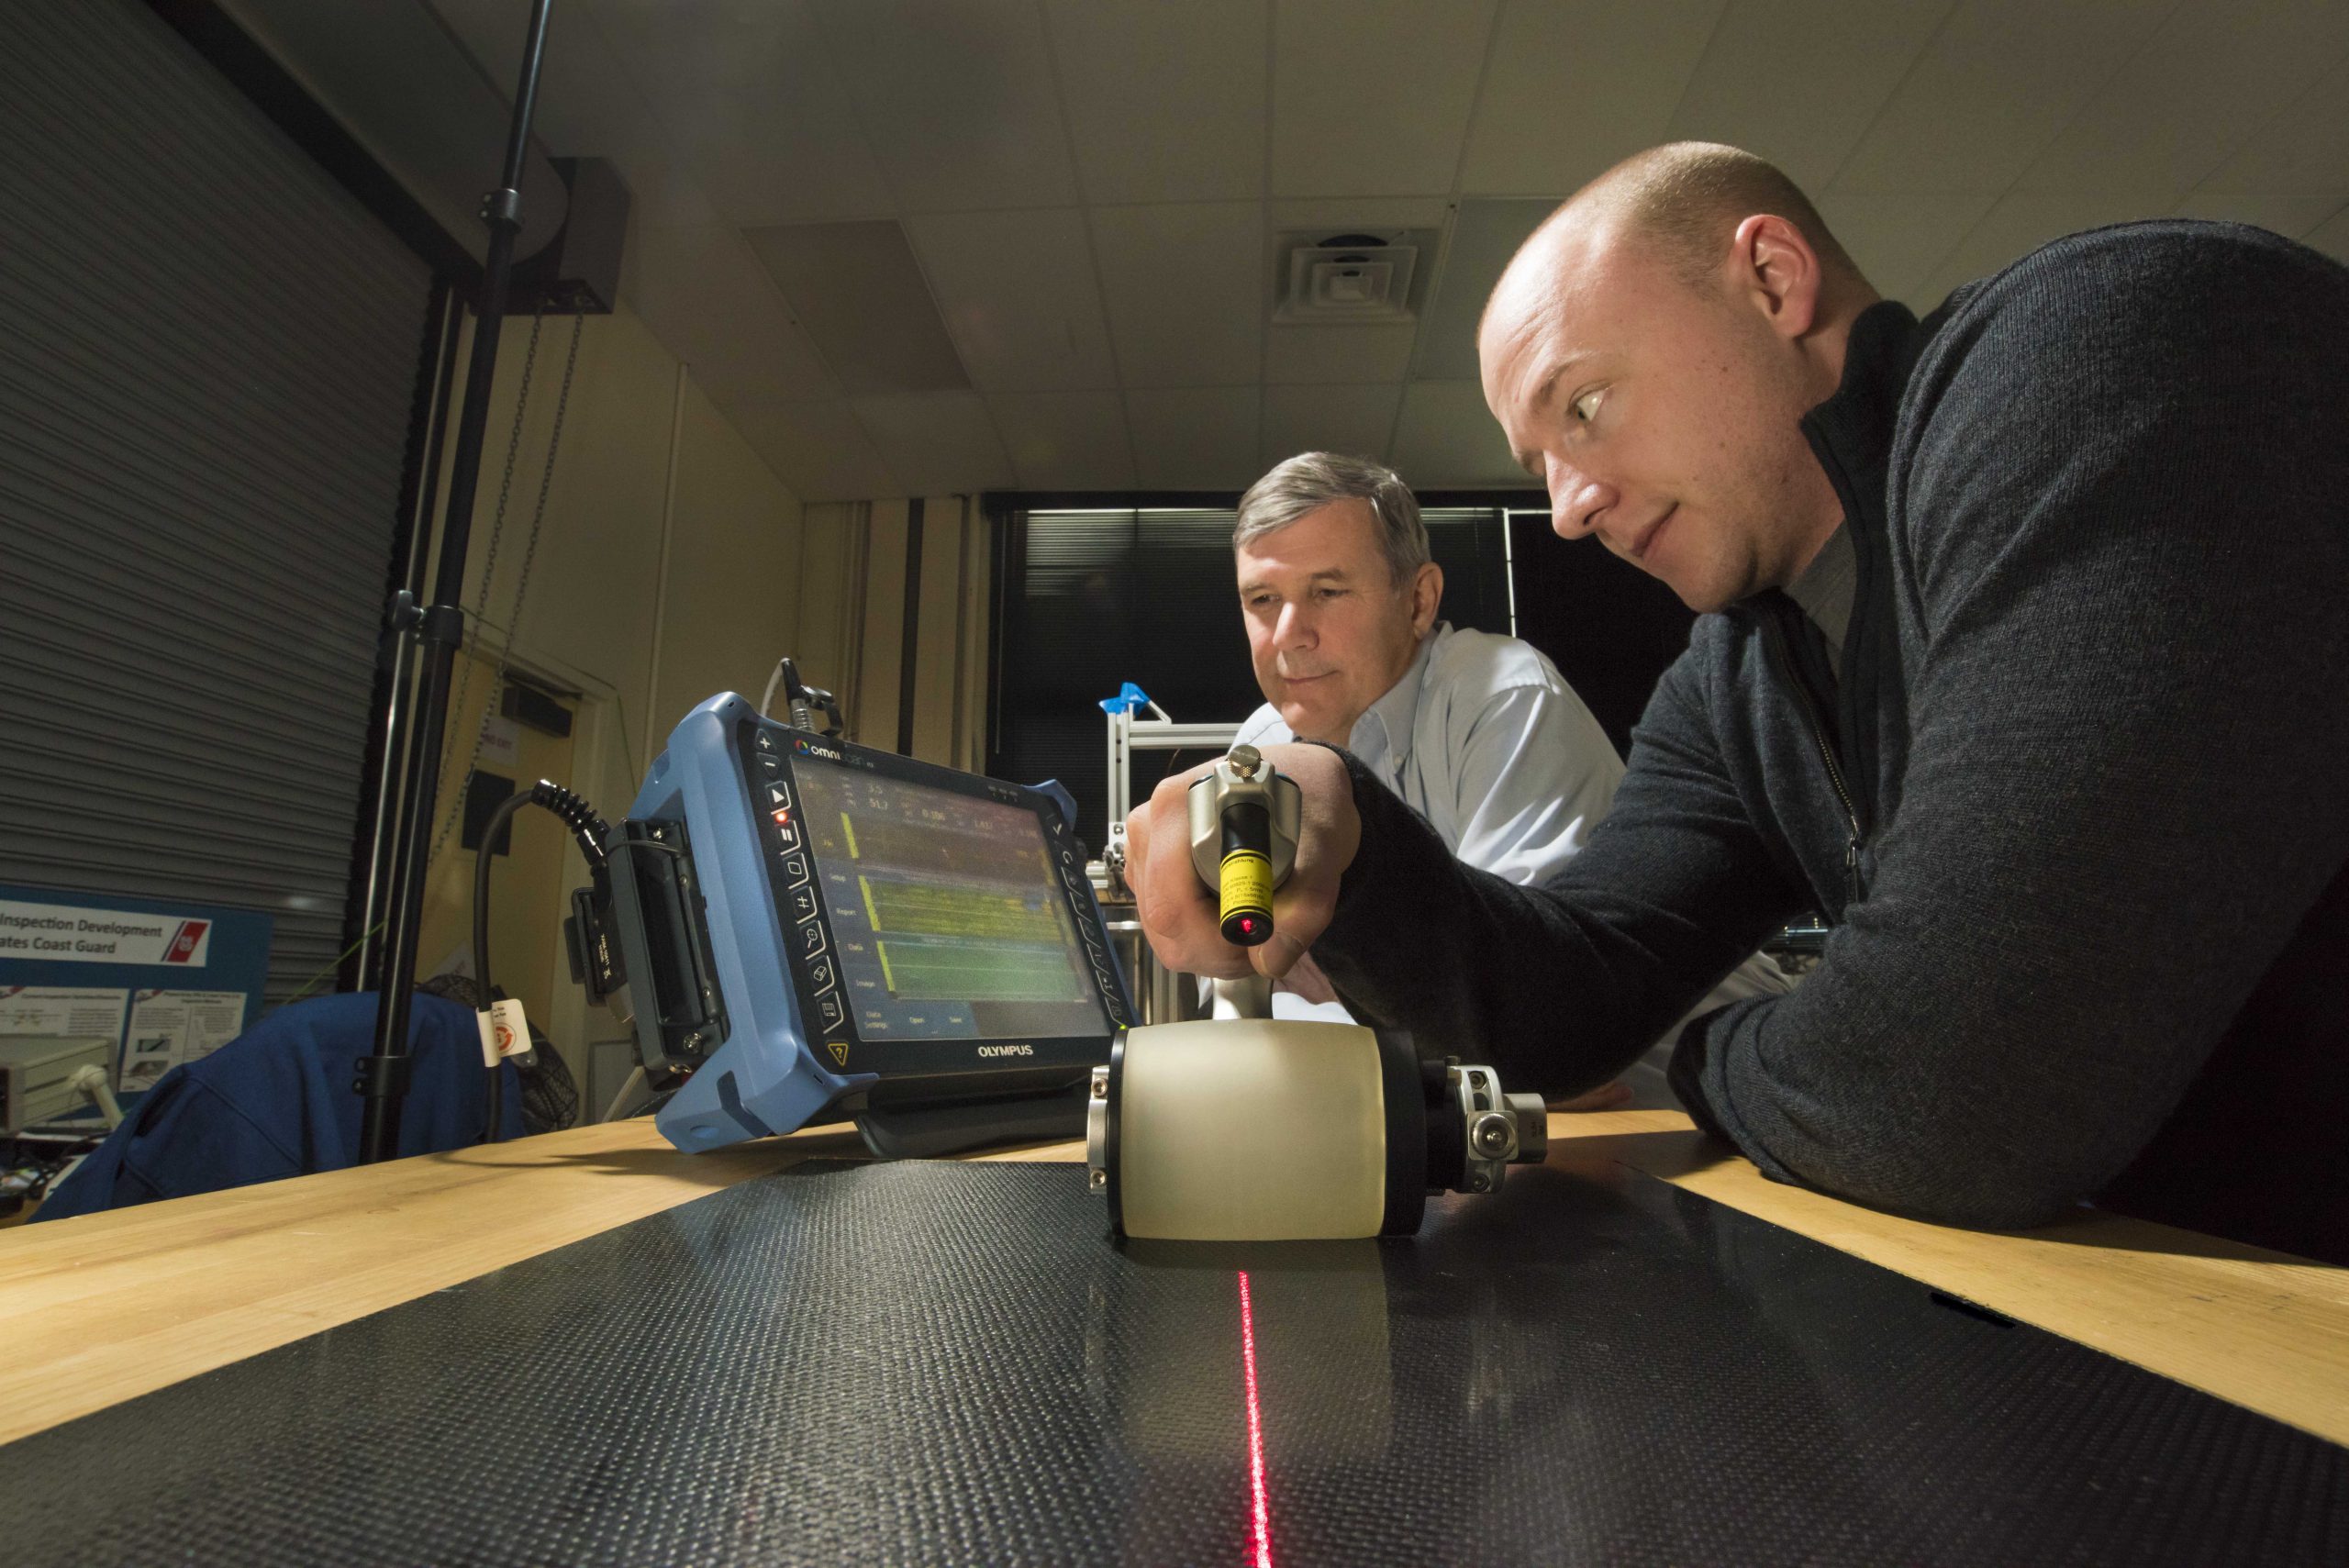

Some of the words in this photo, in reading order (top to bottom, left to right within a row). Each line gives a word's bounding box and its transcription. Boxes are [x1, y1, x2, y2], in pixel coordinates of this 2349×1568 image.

[0, 913, 74, 930] Inspection
[78, 921, 163, 938] Development
[0, 936, 28, 949] ates
[33, 936, 72, 951] Coast
[75, 940, 117, 954] Guard
[977, 1044, 1034, 1058] OLYMPUS
